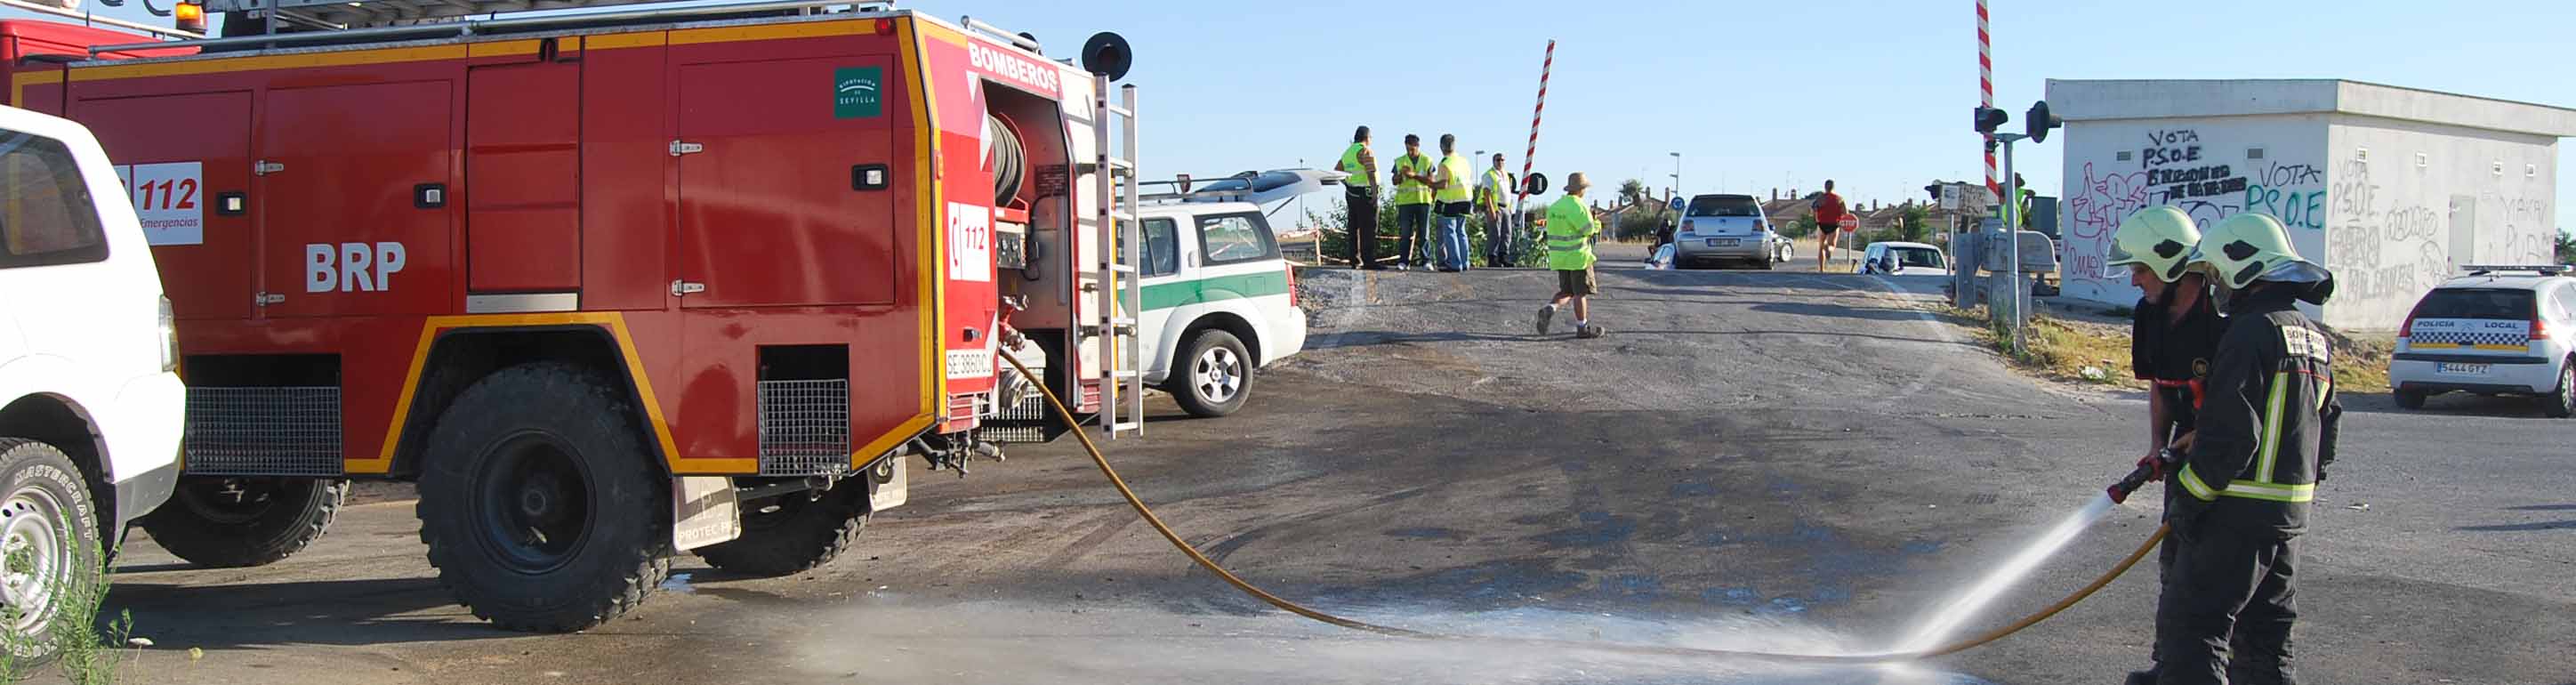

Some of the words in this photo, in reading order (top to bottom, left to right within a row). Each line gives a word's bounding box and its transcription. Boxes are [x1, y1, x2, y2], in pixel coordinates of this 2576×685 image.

[967, 41, 1059, 92] BOMBEROS
[2148, 129, 2199, 146] VOTA
[2259, 160, 2322, 187] VOTA
[140, 178, 197, 210] 112
[141, 216, 198, 230] Emergencias
[1840, 220, 1856, 228] STOP
[965, 224, 985, 250] 112
[306, 241, 407, 292] BRP
[948, 354, 958, 375] SE
[14, 463, 94, 542] MASTERCRAFT
